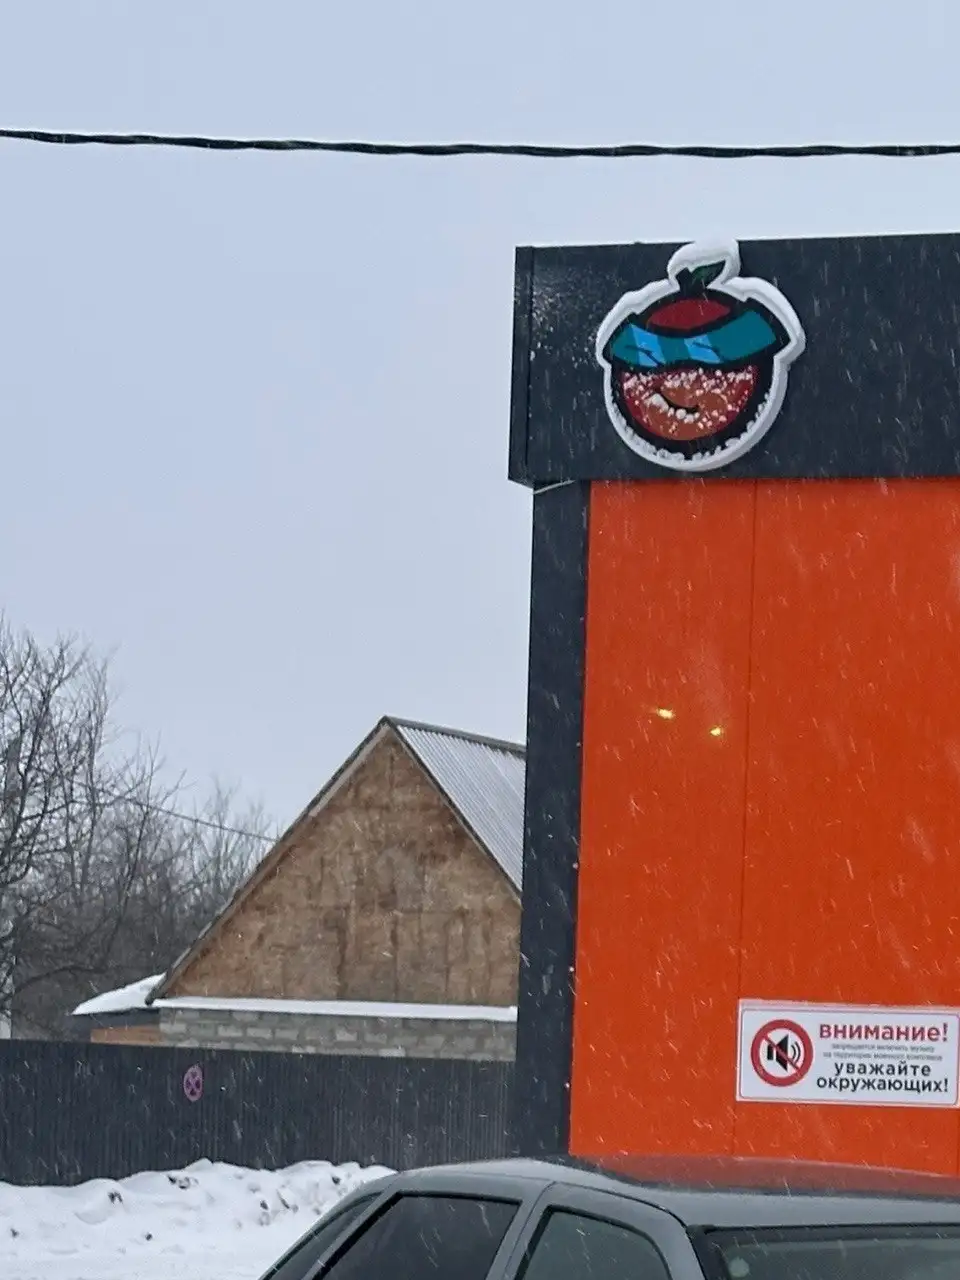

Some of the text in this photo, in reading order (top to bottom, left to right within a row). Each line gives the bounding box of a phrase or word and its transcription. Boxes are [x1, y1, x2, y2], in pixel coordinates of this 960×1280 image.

[819, 1022, 948, 1042] внимание!
[834, 1060, 932, 1077] уважайте
[816, 1076, 949, 1094] окружающих!
